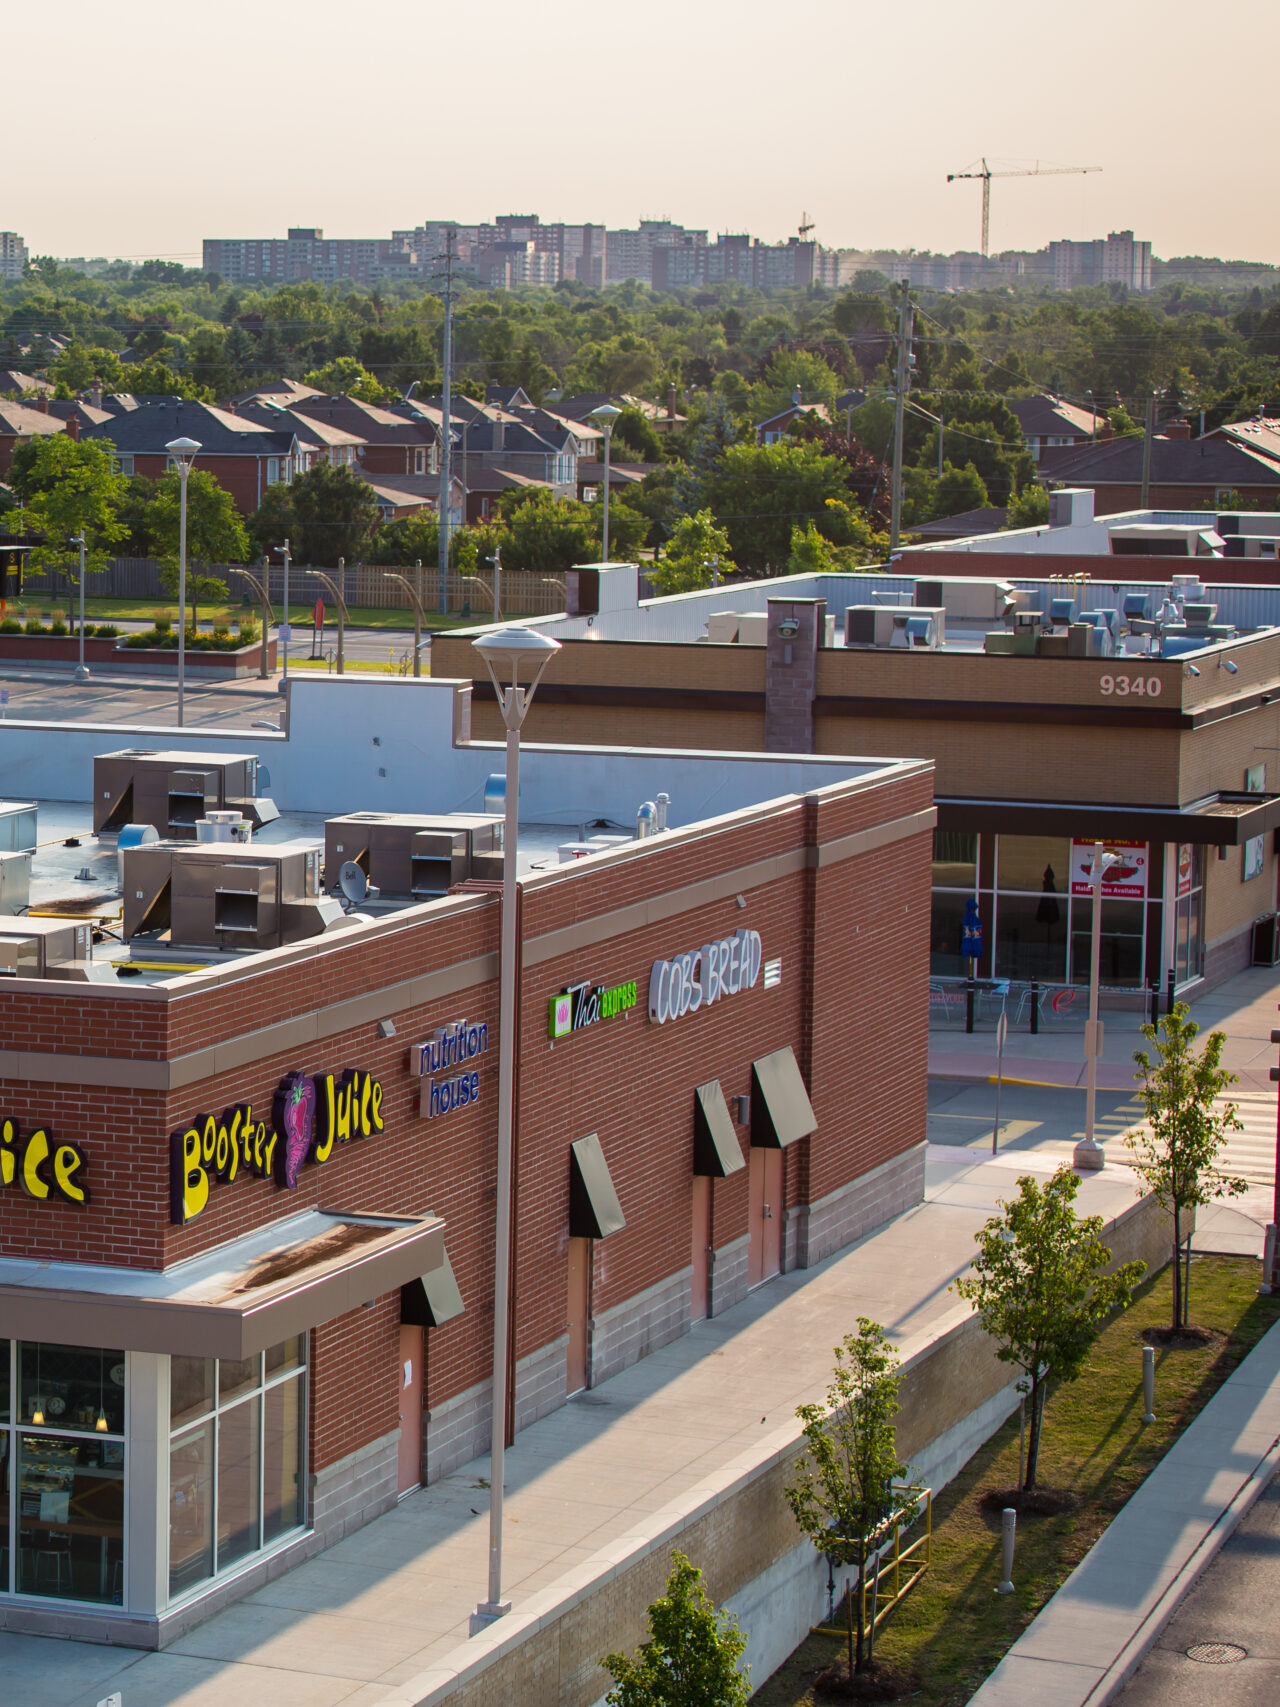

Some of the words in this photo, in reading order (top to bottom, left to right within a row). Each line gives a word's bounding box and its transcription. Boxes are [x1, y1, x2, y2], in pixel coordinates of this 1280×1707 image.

[1100, 675, 1162, 697] 9340
[601, 981, 637, 1018] express
[651, 950, 703, 1025] COBS
[701, 929, 762, 1006] BREAD
[418, 1019, 488, 1077] nutrition
[427, 1071, 480, 1119] house
[177, 1104, 278, 1223] Booster
[314, 1069, 385, 1164] Juice
